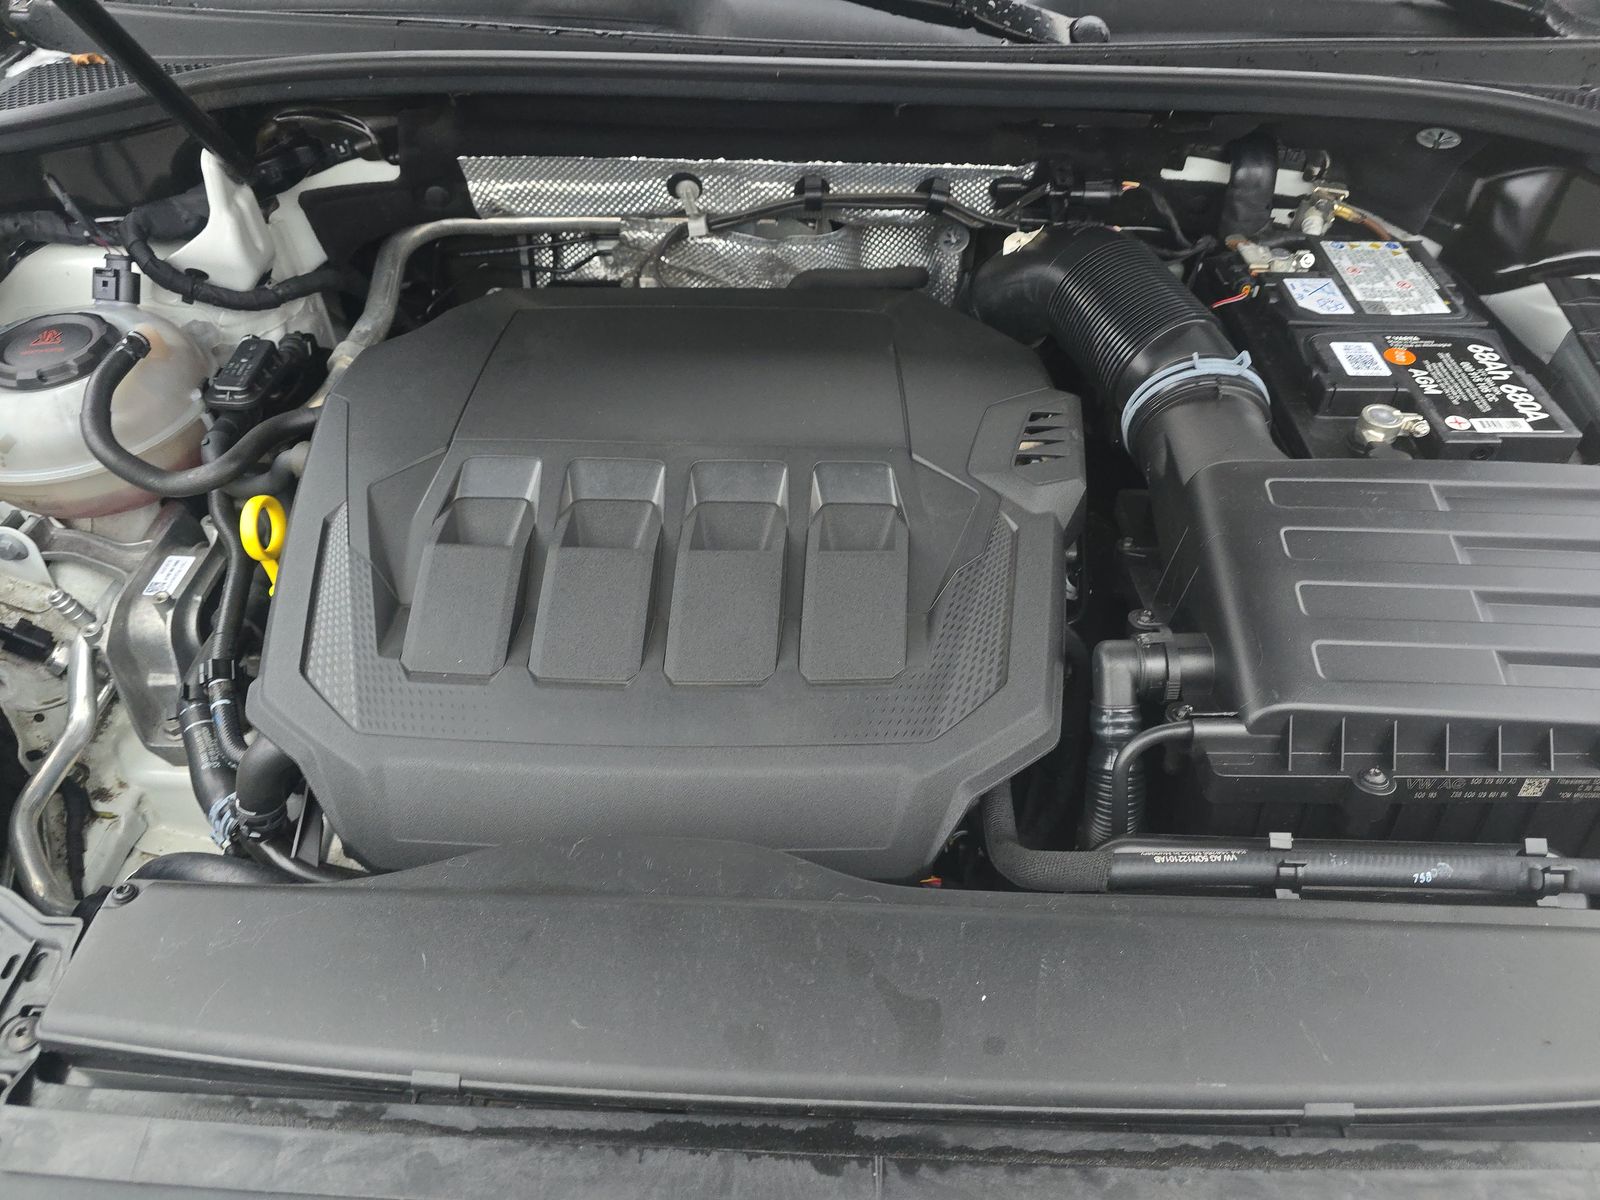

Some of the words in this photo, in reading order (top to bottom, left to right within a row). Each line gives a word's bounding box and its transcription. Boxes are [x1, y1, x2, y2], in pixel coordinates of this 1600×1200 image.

[1408, 368, 1443, 395] AGM
[1467, 344, 1513, 381] 68Ah
[1500, 384, 1549, 422] 680A
[1406, 778, 1438, 789] VW
[1438, 778, 1467, 789] AG
[1223, 854, 1238, 862] VW
